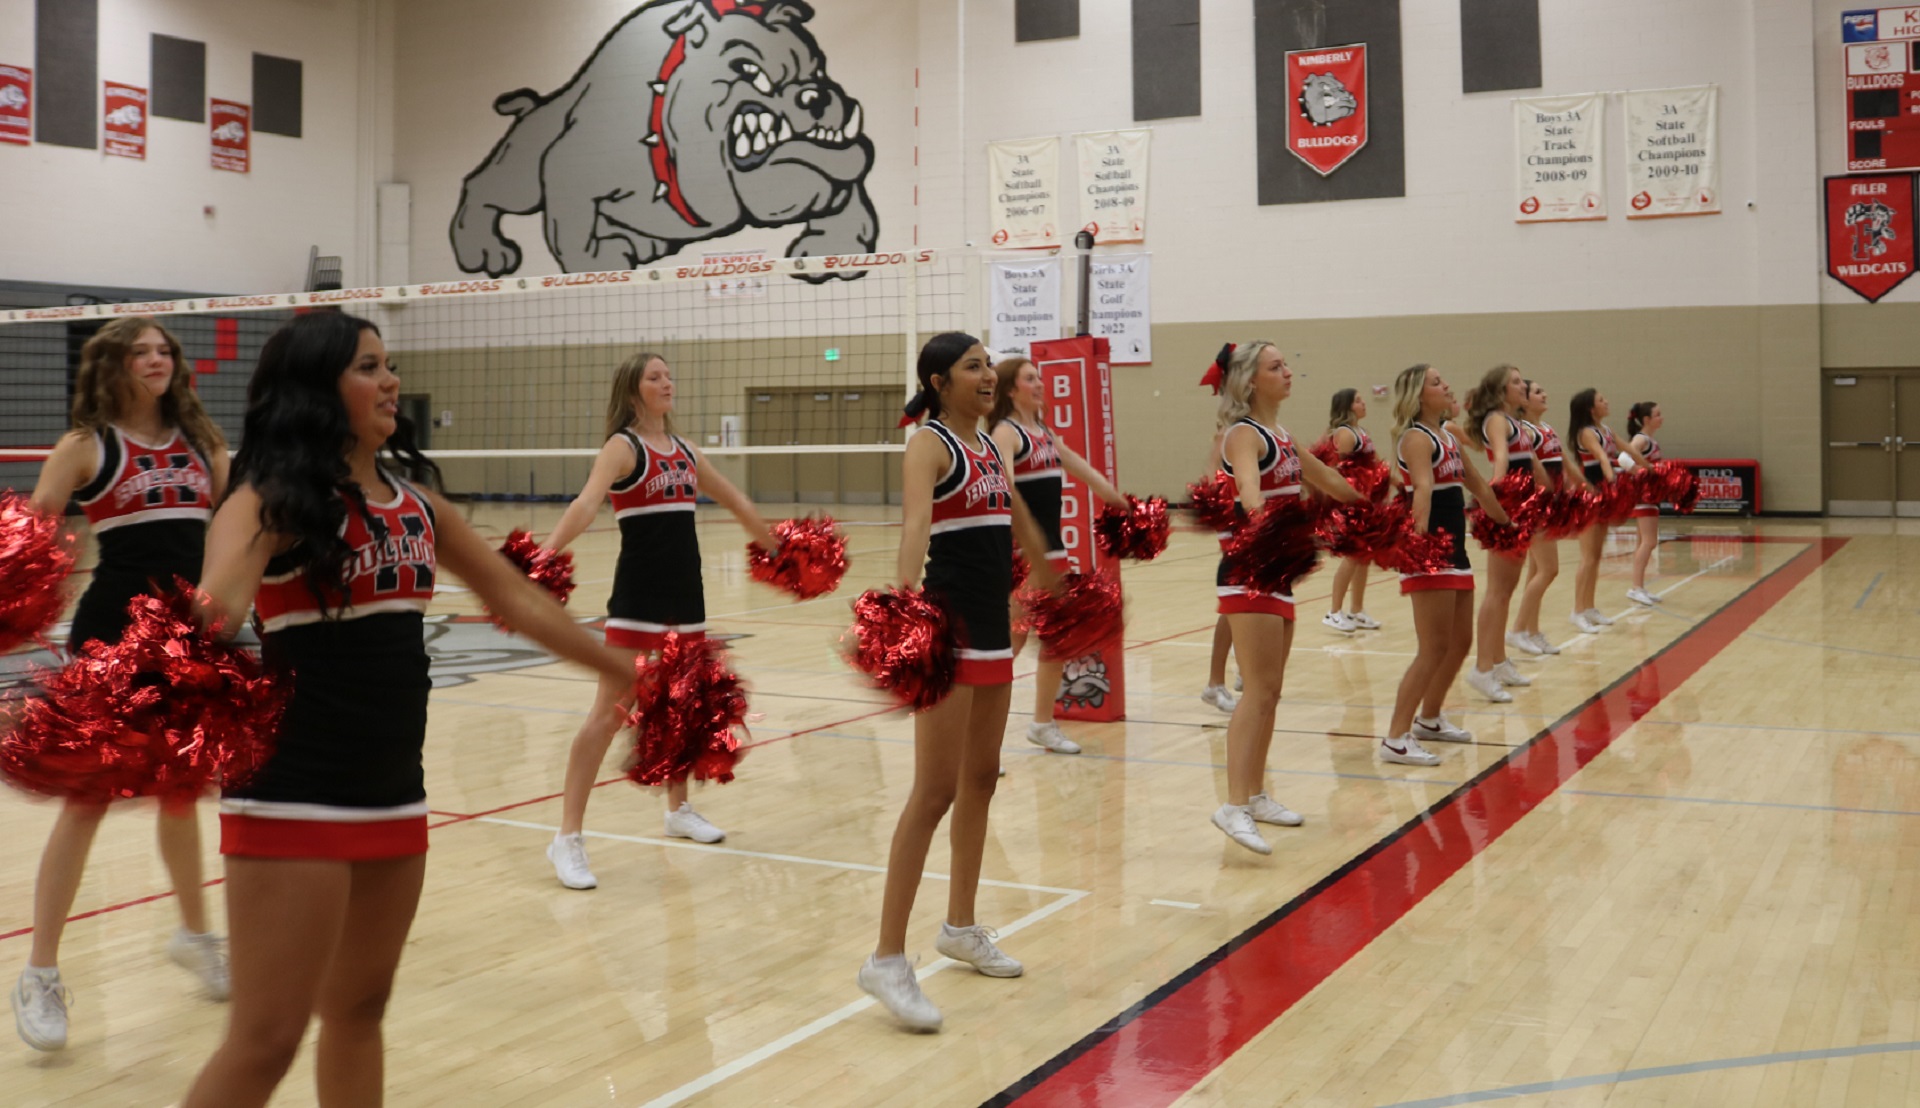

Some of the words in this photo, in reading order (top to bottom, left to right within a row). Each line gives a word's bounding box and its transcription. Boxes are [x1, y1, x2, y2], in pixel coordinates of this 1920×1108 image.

[1843, 14, 1875, 24] PEPSI
[1298, 51, 1354, 66] KIMBERLY
[1847, 74, 1904, 89] BULLDOGS
[1661, 104, 1678, 115] 3A
[1536, 112, 1562, 124] Boys
[1566, 111, 1581, 121] 3A
[1544, 125, 1574, 137] State
[1655, 119, 1685, 131] State
[1849, 119, 1885, 130] FOULS
[1297, 135, 1358, 148] BULLDOGS
[1543, 140, 1576, 151] Track
[1647, 132, 1695, 147] Softball
[1527, 153, 1593, 166] Champions
[1638, 148, 1706, 161] Champions
[1849, 158, 1886, 169] SCORE
[1535, 169, 1587, 182] 2008-09
[1648, 164, 1699, 178] 2009-10
[1851, 182, 1888, 195] FILER
[824, 250, 934, 268] BULLDOS
[676, 260, 777, 279] BULLDOGS
[1837, 261, 1907, 276] WILDCATS
[541, 271, 634, 287] BULLDOGS
[1097, 280, 1126, 290] State
[419, 280, 503, 296] BULLDOGS
[1012, 283, 1037, 294] State
[309, 287, 385, 303] BULLDOGS
[1100, 294, 1126, 305] Golf
[1013, 296, 1037, 308] Golf
[996, 312, 1054, 324] Champions
[1091, 309, 1143, 321] hampions
[1013, 326, 1038, 337] 2022
[1101, 323, 1126, 334] 2022
